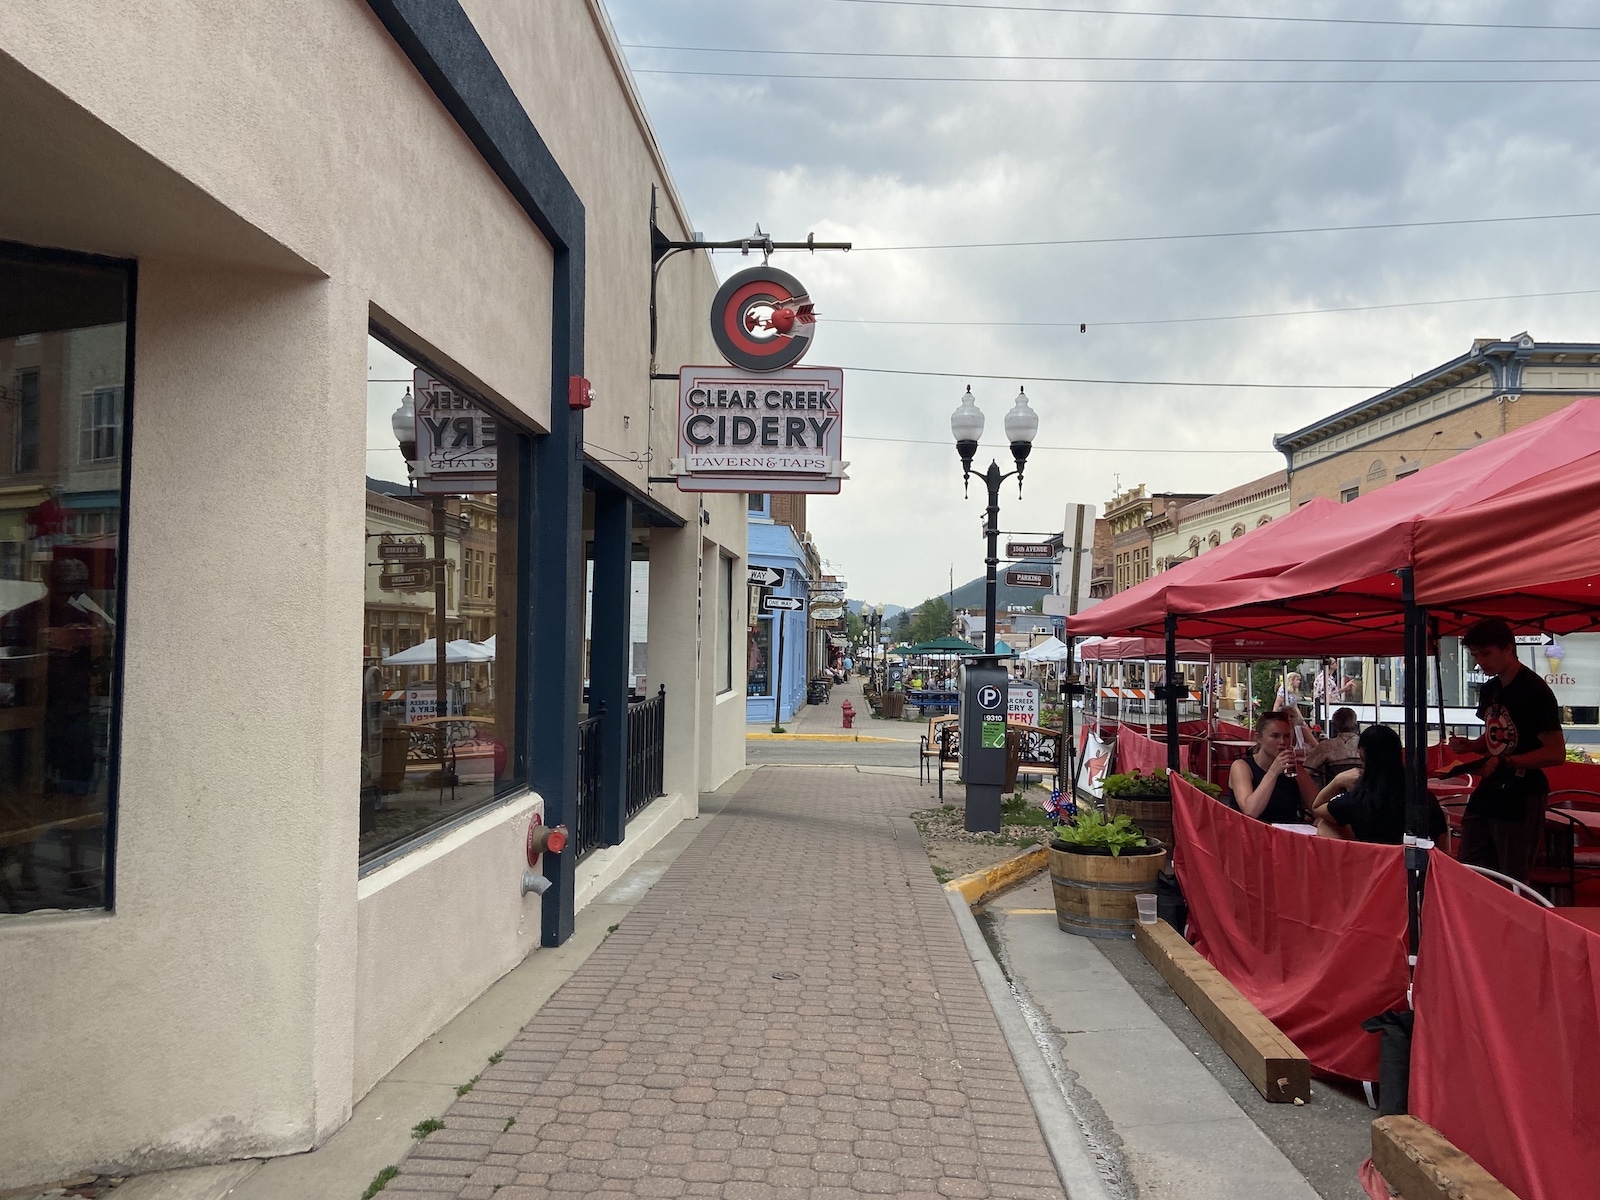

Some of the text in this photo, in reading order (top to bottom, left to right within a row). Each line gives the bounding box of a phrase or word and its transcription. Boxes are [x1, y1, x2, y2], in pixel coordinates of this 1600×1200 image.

[689, 389, 832, 410] CLEAR CREEK
[686, 414, 833, 448] CIDERY
[751, 571, 767, 580] WAY
[1016, 574, 1042, 582] PARKING
[1544, 673, 1576, 685] Gifts
